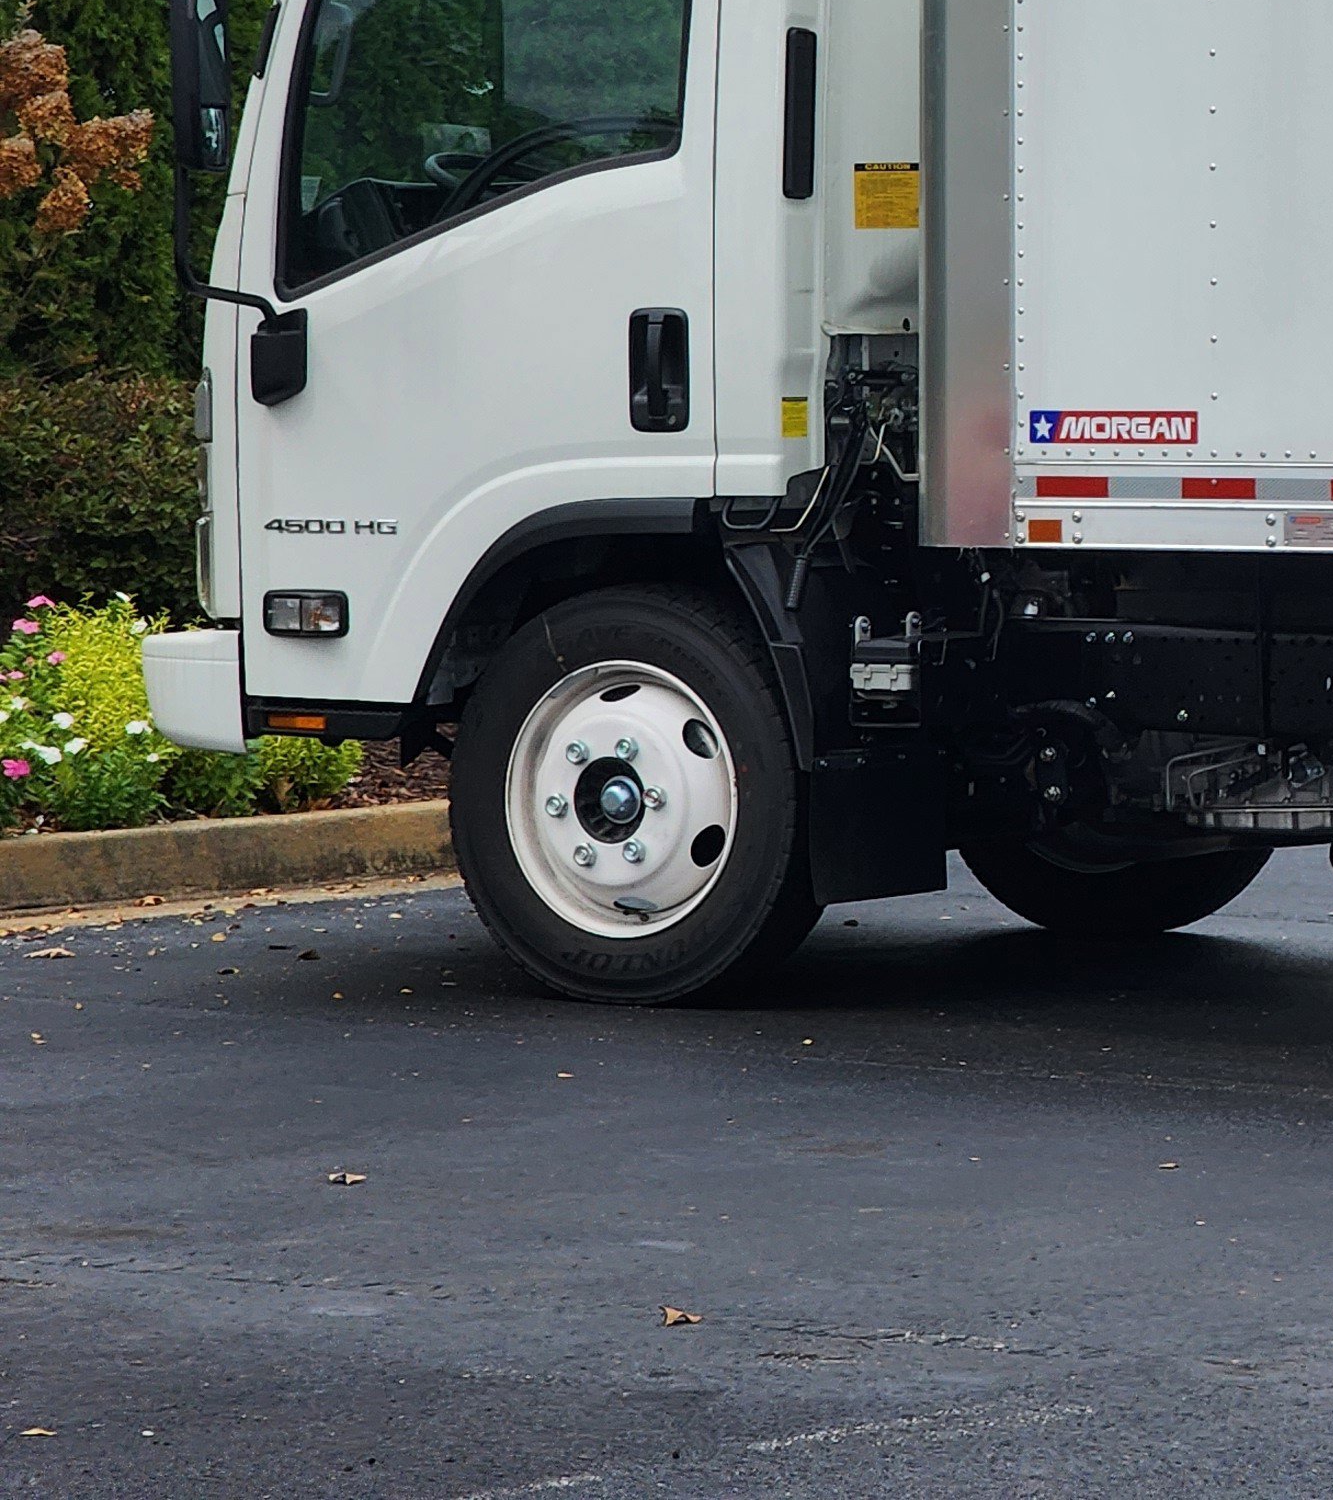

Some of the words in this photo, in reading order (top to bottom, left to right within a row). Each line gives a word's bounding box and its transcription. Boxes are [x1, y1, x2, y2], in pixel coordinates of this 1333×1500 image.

[865, 163, 911, 171] CAUTION
[1059, 416, 1193, 441] MORGAN
[264, 518, 346, 534] 4500
[354, 518, 398, 535] HG
